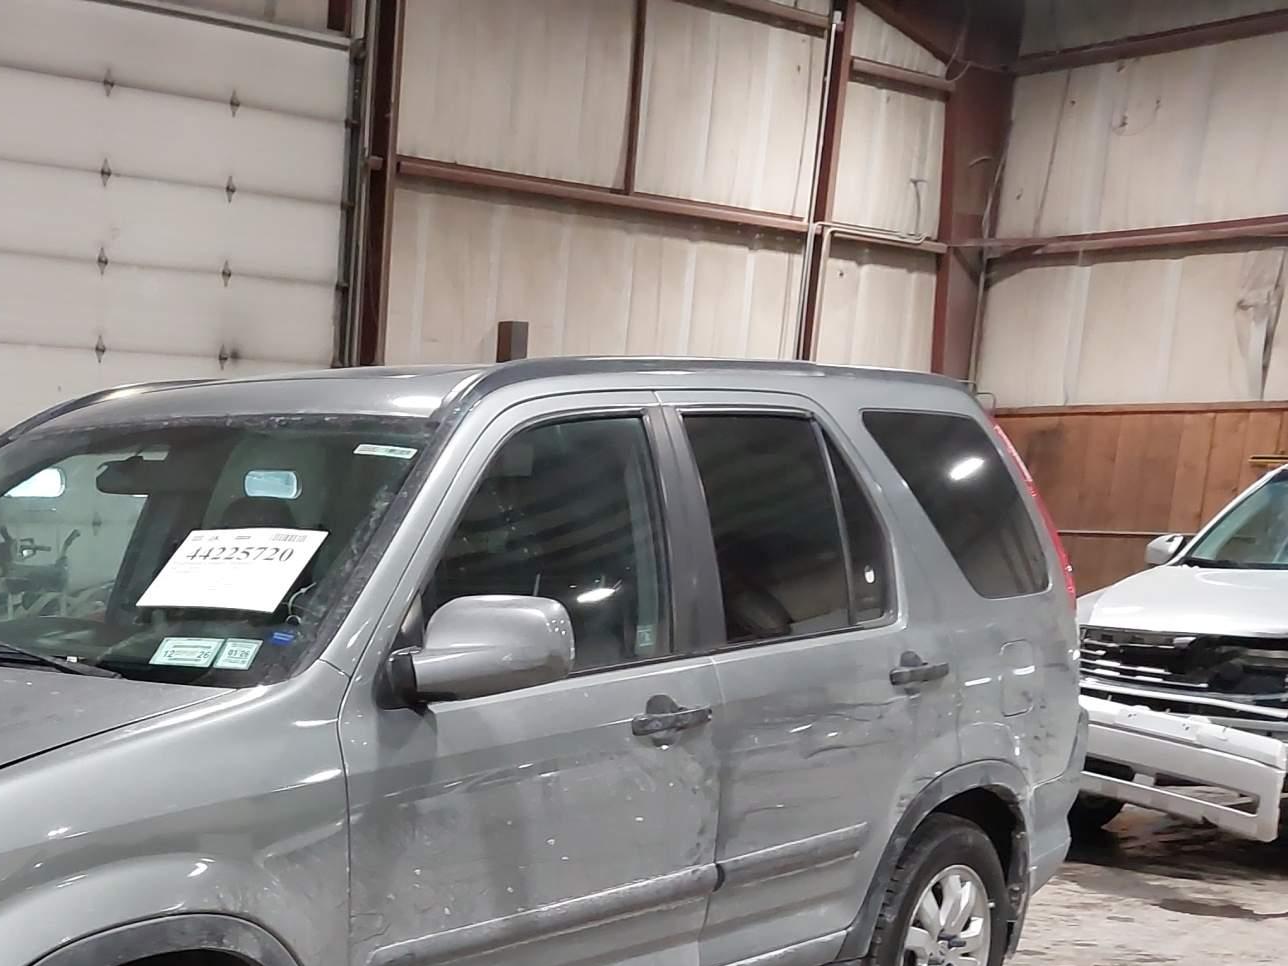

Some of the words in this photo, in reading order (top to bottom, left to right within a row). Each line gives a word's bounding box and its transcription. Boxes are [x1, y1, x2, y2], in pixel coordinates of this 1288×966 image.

[186, 547, 294, 562] 44225720
[163, 649, 176, 658] 12
[196, 650, 211, 659] 26
